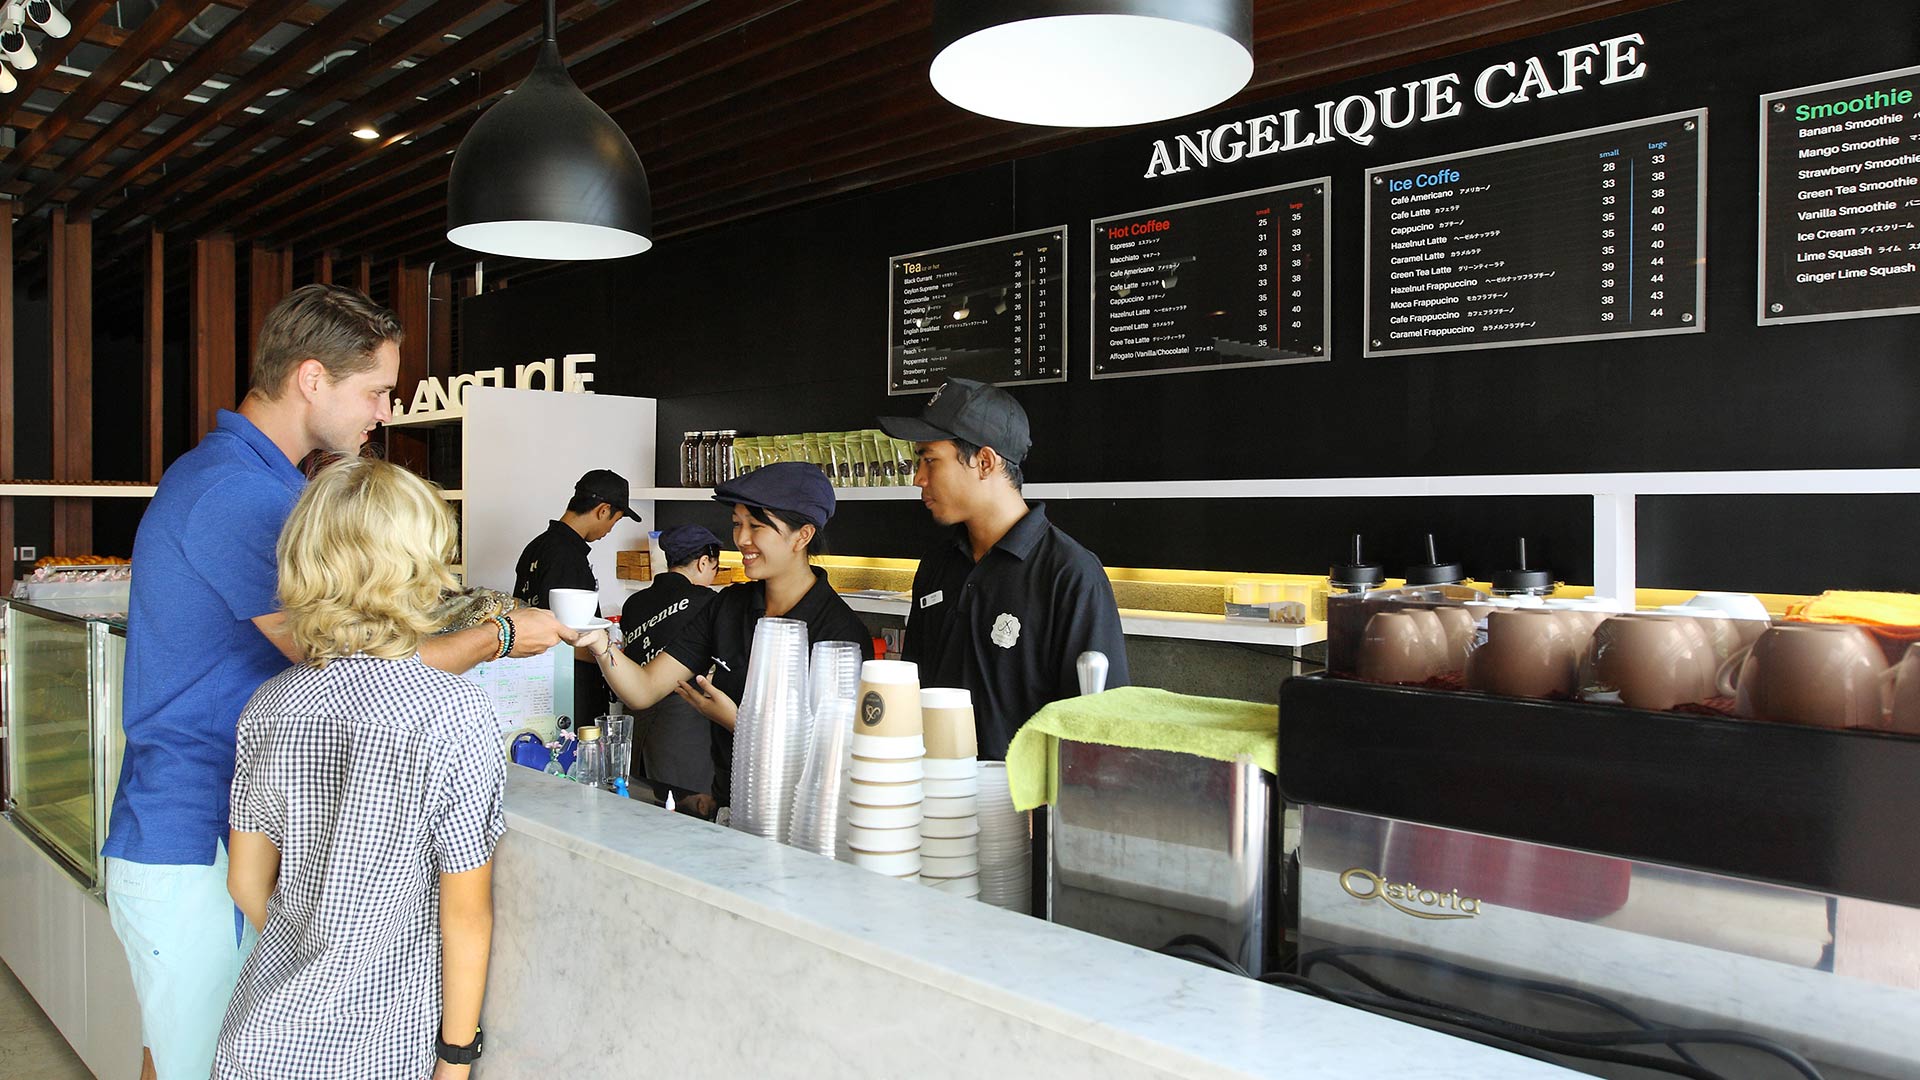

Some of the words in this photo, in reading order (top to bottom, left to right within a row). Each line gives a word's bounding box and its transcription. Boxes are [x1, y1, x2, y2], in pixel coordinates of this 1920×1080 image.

[1143, 73, 1462, 179] ANGELIQUE
[1473, 32, 1647, 109] CAFE
[1795, 88, 1913, 122] Smoothie
[1799, 124, 1843, 138] Banana
[1844, 113, 1904, 131] Smoothie
[1648, 141, 1668, 150] large
[1798, 146, 1840, 159] Mango
[1841, 135, 1900, 152] Smoothie
[1599, 148, 1620, 159] small
[1651, 154, 1666, 165] 33
[1603, 162, 1616, 172] 28
[1798, 163, 1863, 180] Strawberry
[1389, 179, 1413, 193] Ice
[1416, 168, 1460, 188] Coffe
[1651, 171, 1665, 182] 38
[1602, 179, 1616, 189] 33
[1797, 188, 1834, 200] Green
[1834, 185, 1857, 195] Tea
[1858, 176, 1919, 192] Smoothie
[1410, 190, 1454, 203] Americano
[1651, 188, 1665, 199] 38
[1602, 195, 1616, 206] 33
[1410, 208, 1431, 218] Latte
[1651, 205, 1665, 215] 40
[1797, 208, 1837, 221] Vanilla
[1838, 200, 1897, 216] Smoothie
[1291, 212, 1302, 222] 35
[1602, 212, 1615, 222] 35
[1258, 218, 1268, 227] 25
[1651, 222, 1665, 232] 40
[1108, 225, 1129, 240] Hot
[1130, 219, 1171, 236] Coffee
[1291, 228, 1302, 237] 39
[1602, 229, 1615, 239] 35
[1258, 233, 1267, 242] 31
[1797, 232, 1816, 242] Ice
[1816, 228, 1856, 240] Cream
[1291, 243, 1302, 252] 33
[1391, 238, 1426, 250] Hazelnut
[1426, 236, 1448, 246] Latte
[1651, 239, 1665, 249] 40
[1258, 248, 1268, 257] 28
[1602, 245, 1615, 255] 35
[1797, 252, 1827, 263] Lime
[1827, 245, 1873, 260] Squash
[1291, 259, 1302, 267] 38
[1390, 253, 1424, 265] Caramel
[1424, 252, 1445, 261] Latte
[1650, 257, 1665, 266] 44
[902, 262, 922, 275] Tea
[1258, 263, 1268, 272] 33
[1601, 262, 1615, 272] 39
[1390, 271, 1415, 280] Green
[1415, 269, 1430, 277] Tea
[1431, 266, 1452, 275] Latte
[1796, 272, 1837, 284] Ginger
[1838, 269, 1868, 279] Lime
[1869, 262, 1916, 277] Squash
[1258, 278, 1268, 287] 33
[1291, 274, 1302, 283] 38
[1650, 274, 1664, 283] 44
[1390, 284, 1425, 295] Hazelnut
[1426, 278, 1478, 291] Frappuccino
[1601, 279, 1615, 289] 39
[1258, 293, 1268, 302] 35
[1291, 289, 1302, 298] 40
[1650, 291, 1664, 300] 43
[1601, 295, 1614, 305] 38
[1291, 305, 1302, 313] 40
[1390, 301, 1412, 310] Moca
[1258, 308, 1268, 317] 35
[1601, 312, 1614, 322] 39
[1650, 308, 1664, 317] 44
[1390, 315, 1409, 325] Cafe
[1409, 311, 1460, 323] Frappuccino
[1258, 324, 1268, 332] 35
[1291, 320, 1302, 329] 40
[1390, 329, 1423, 339] Caramel
[1423, 325, 1475, 337] Frappuccino
[1258, 339, 1268, 348] 35
